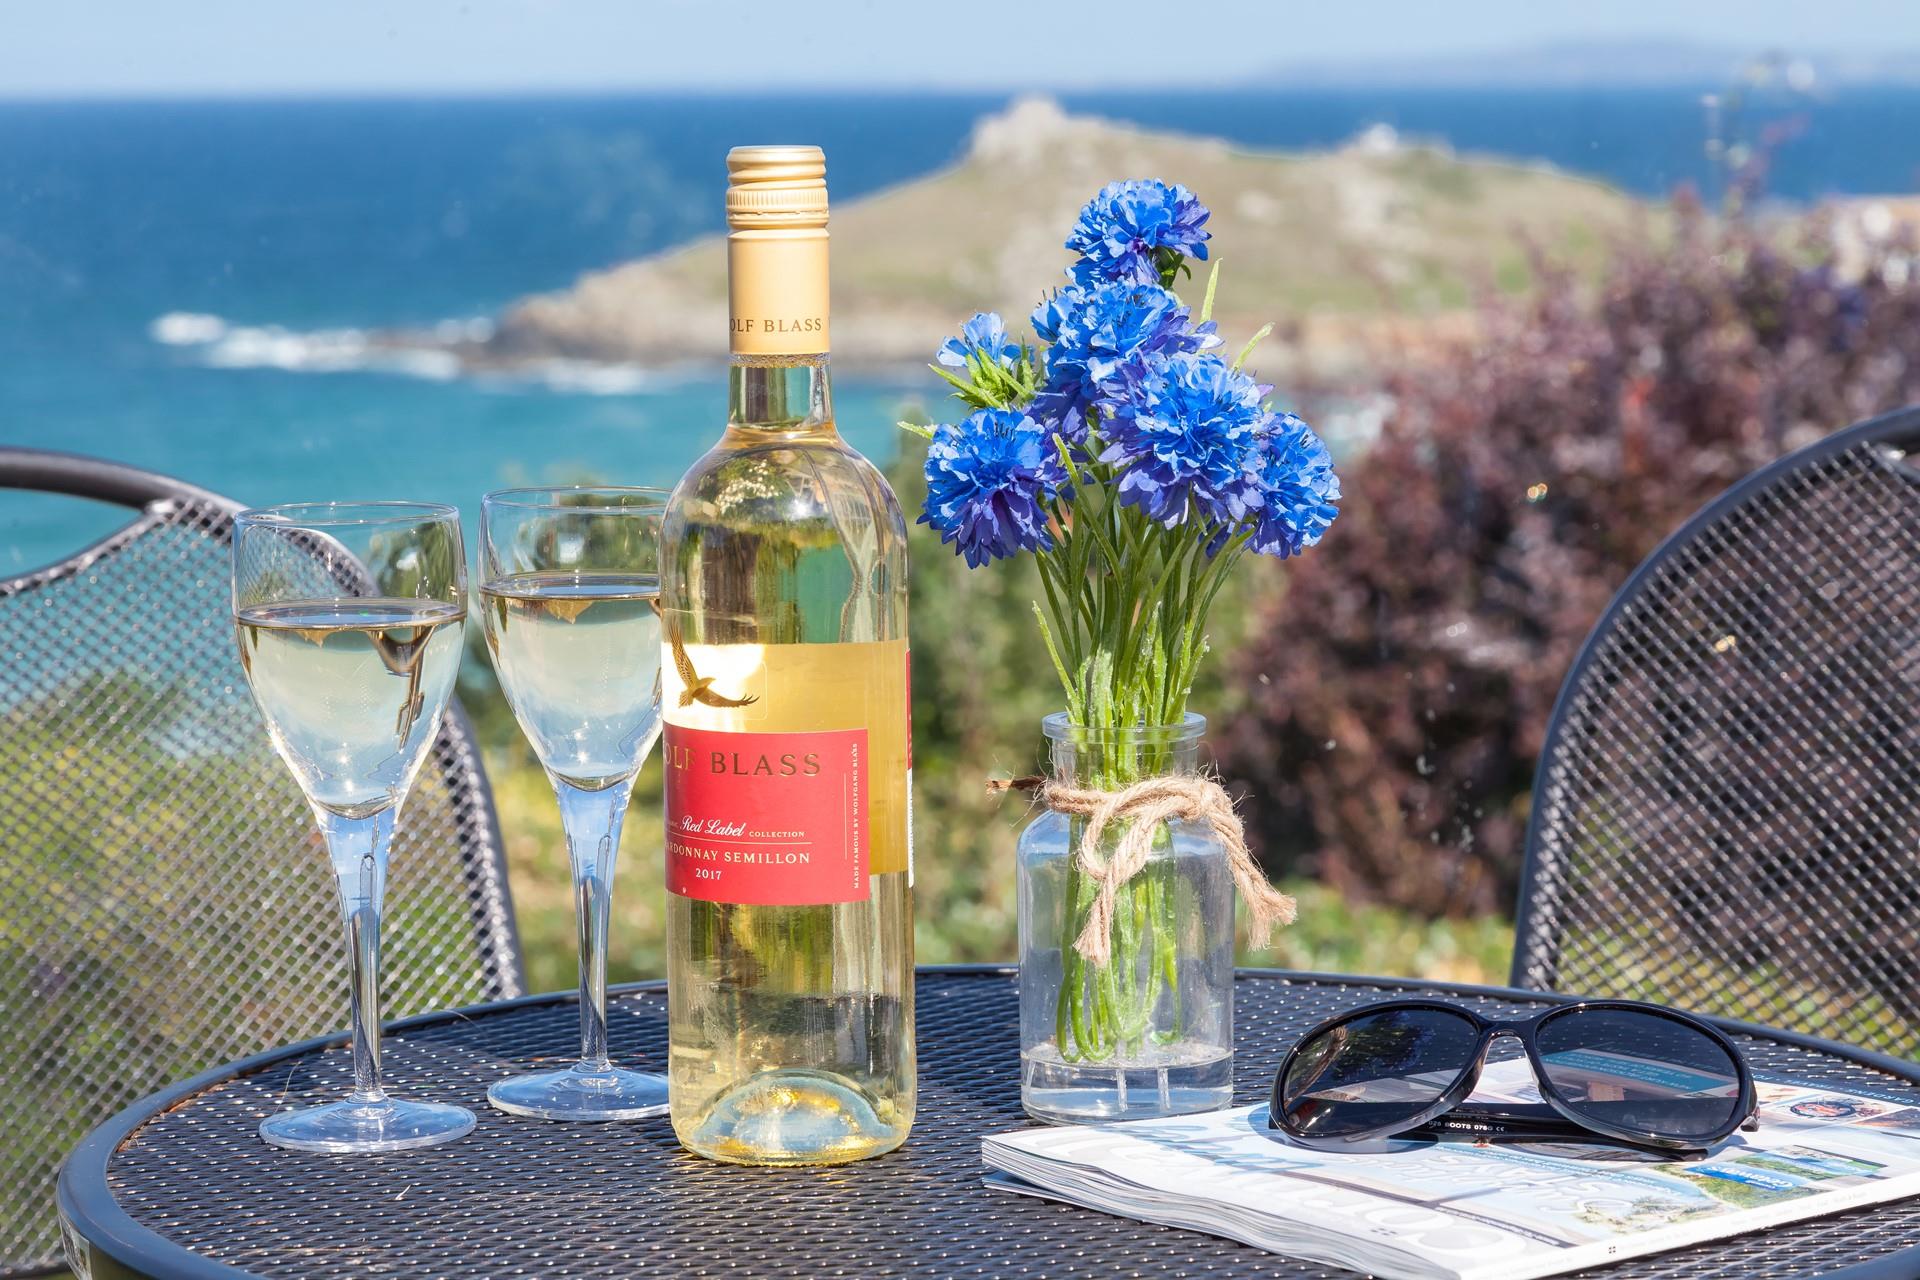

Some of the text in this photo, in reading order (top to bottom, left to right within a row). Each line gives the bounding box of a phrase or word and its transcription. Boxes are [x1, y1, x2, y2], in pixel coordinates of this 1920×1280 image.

[730, 318, 822, 332] OLF BLASS
[664, 742, 821, 777] OLF BLASS
[680, 815, 805, 838] Red Label COLLECTION
[853, 818, 859, 828] BY
[724, 851, 810, 864] SEMILLON
[695, 867, 722, 880] 2017
